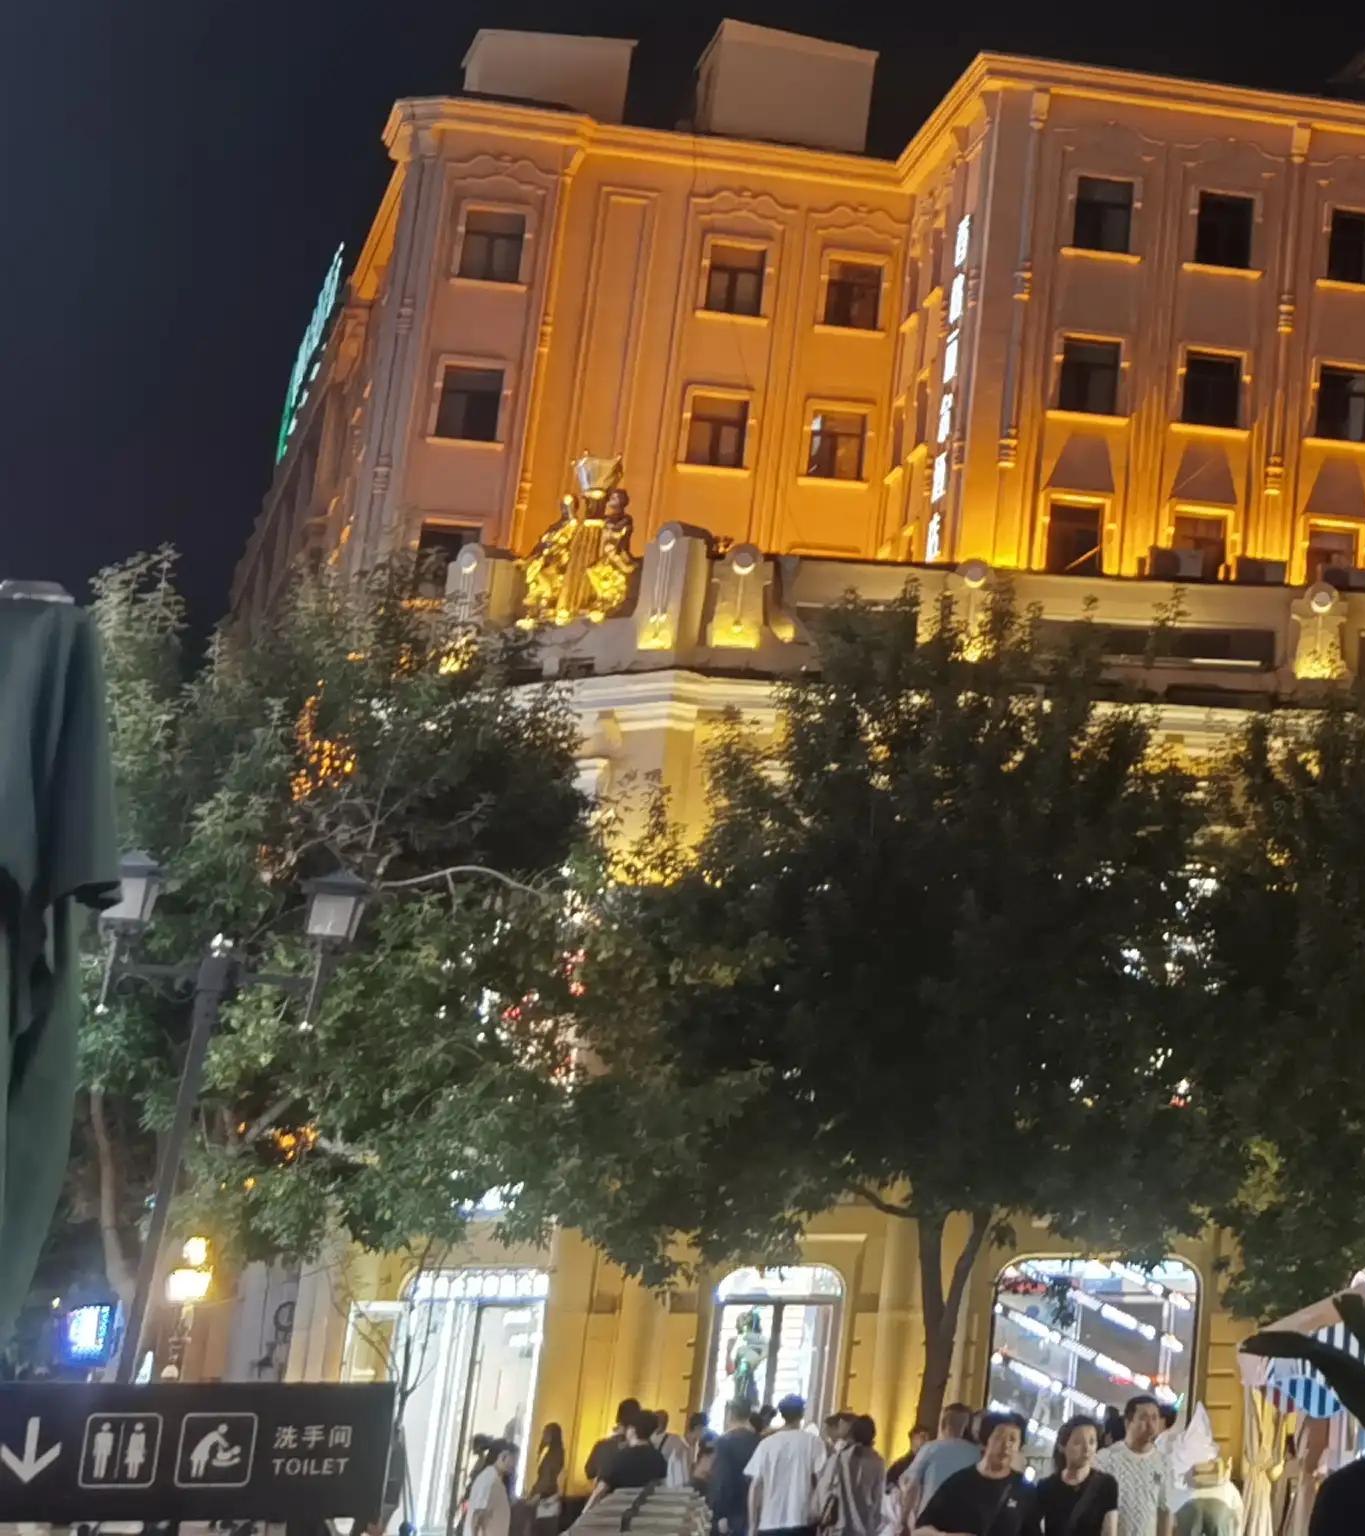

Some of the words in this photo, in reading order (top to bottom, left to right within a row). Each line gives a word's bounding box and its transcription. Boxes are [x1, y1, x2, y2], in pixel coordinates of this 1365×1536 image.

[272, 1424, 353, 1450] 洗手间
[272, 1457, 350, 1476] TOILET
